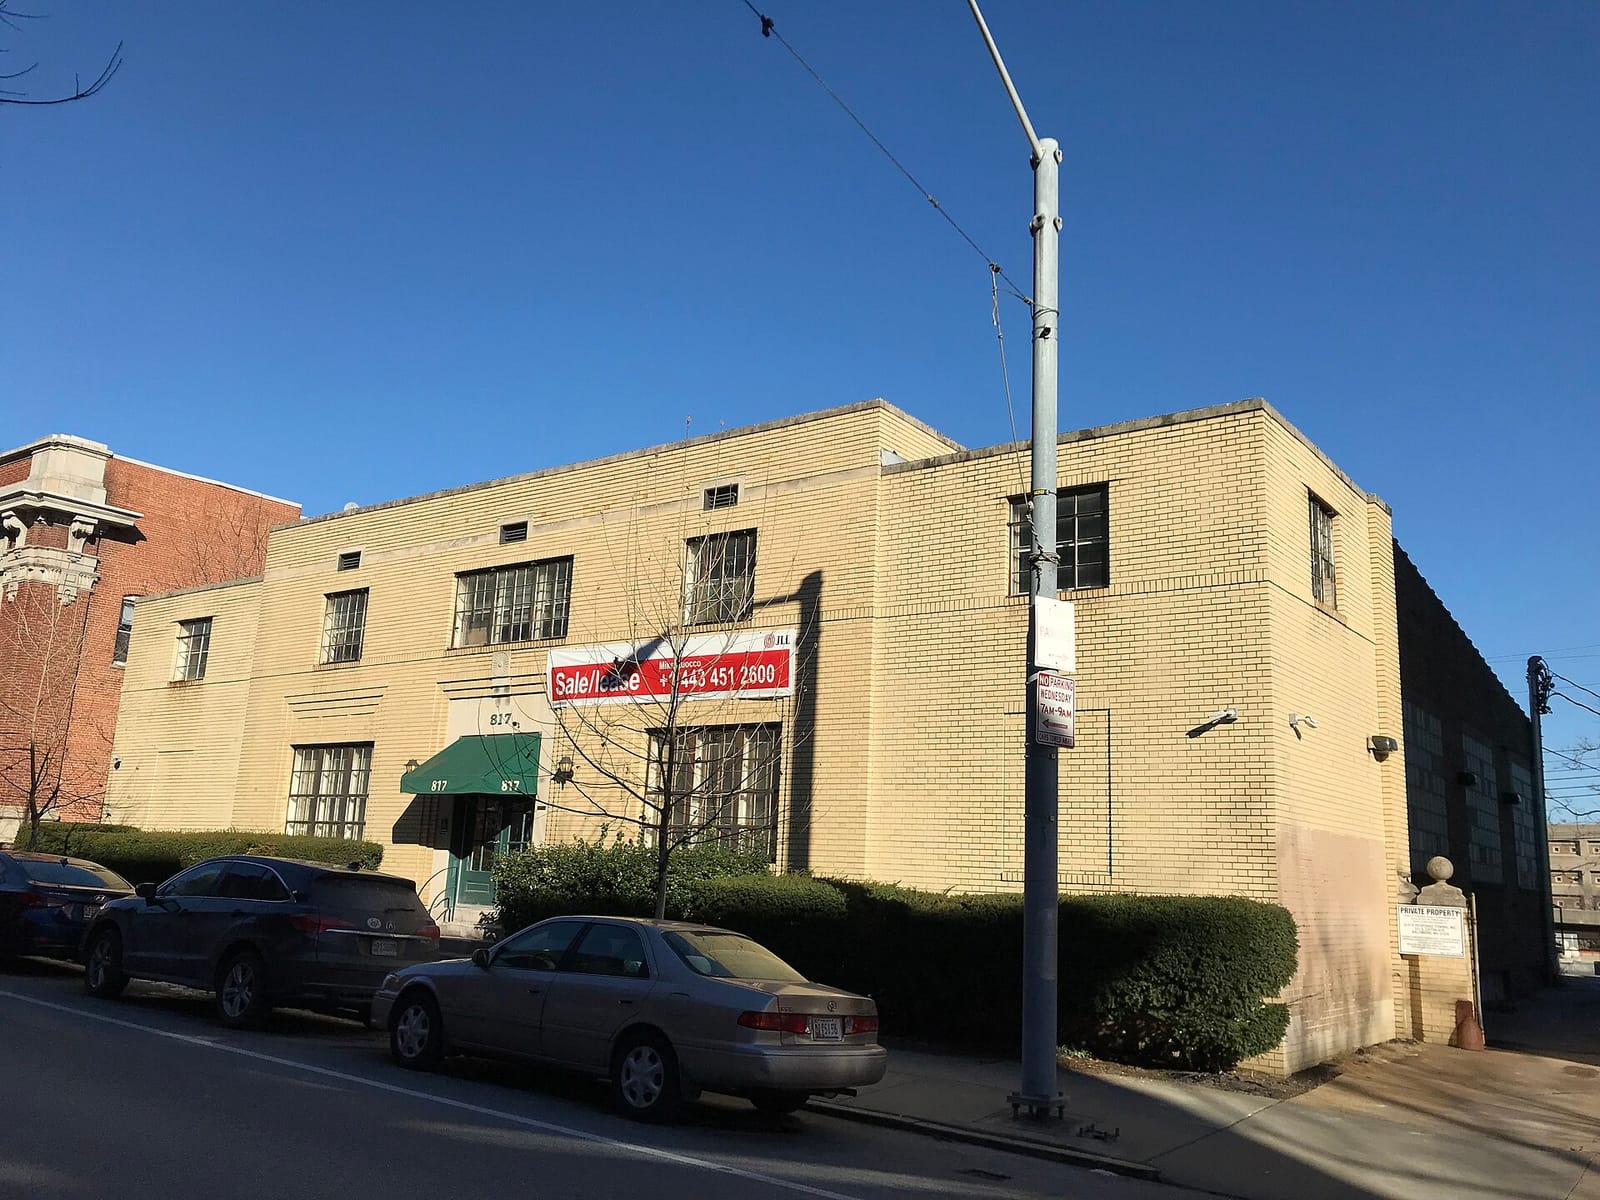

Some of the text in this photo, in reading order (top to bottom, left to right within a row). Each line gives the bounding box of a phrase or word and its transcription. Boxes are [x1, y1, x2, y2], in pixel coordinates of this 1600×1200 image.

[776, 635, 790, 646] JLL
[677, 660, 702, 669] uocco
[680, 668, 706, 688] 443
[710, 667, 735, 687] 451
[740, 663, 776, 686] 2600
[555, 669, 641, 696] Sale/lease
[1040, 675, 1073, 691] NO PARKING
[1040, 688, 1072, 703] WEDNESDAY
[1040, 704, 1072, 718] 7AM-9AM
[490, 713, 512, 725] 817
[431, 780, 447, 791] 817
[501, 780, 519, 791] 817
